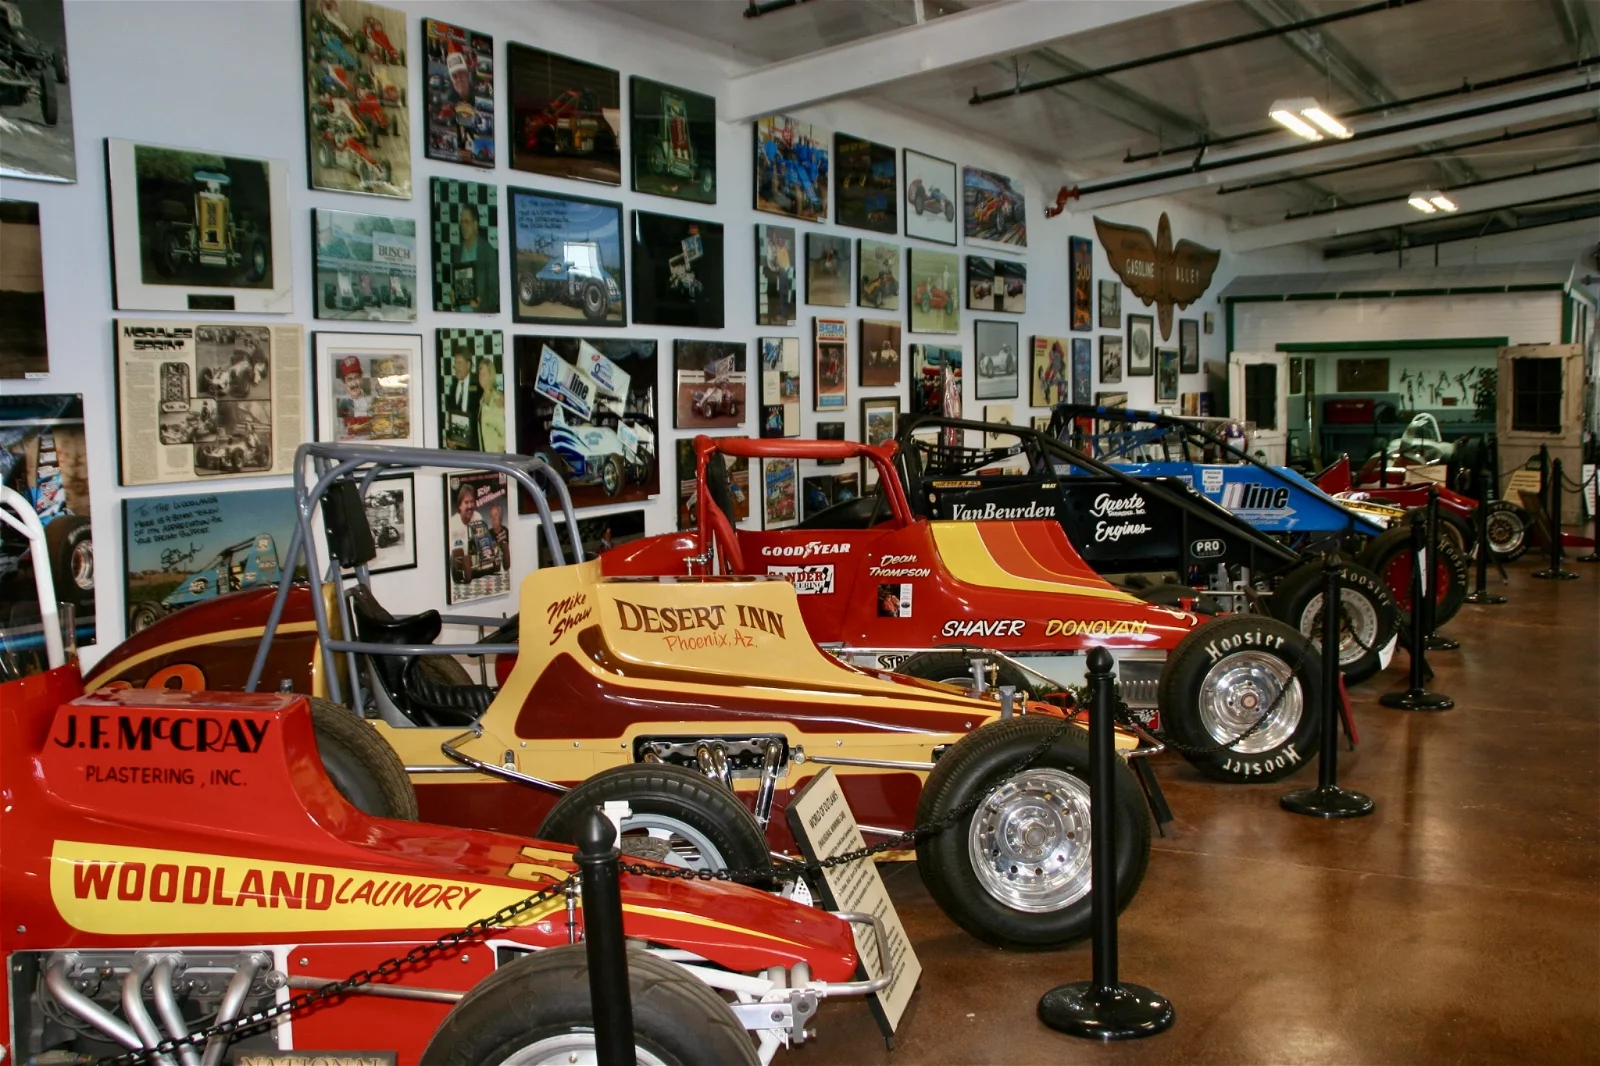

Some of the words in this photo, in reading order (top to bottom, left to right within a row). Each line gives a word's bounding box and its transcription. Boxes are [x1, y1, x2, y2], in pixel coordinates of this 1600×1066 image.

[378, 244, 410, 259] BUSCH
[1075, 261, 1091, 281] 500
[1125, 258, 1155, 279] GASOLINE
[1175, 266, 1199, 284] ALLEY
[123, 326, 193, 339] MORALES
[133, 339, 185, 351] SPRINT
[476, 485, 491, 497] Rip
[952, 500, 1056, 520] VanBeurden
[1089, 492, 1146, 517] Gaerte
[1094, 520, 1152, 542] Engines
[1196, 540, 1220, 552] PRO
[880, 553, 918, 567] Dean
[869, 566, 931, 578] THOMPSON
[547, 591, 587, 625] Mike
[612, 597, 727, 633] DESERT
[735, 604, 787, 640] INN
[549, 606, 593, 646] Shaw
[941, 619, 1026, 637] SHAVER
[1045, 619, 1149, 637] DONOVAN
[663, 630, 732, 652] Phoenix,
[733, 629, 758, 648] Az.
[1204, 627, 1285, 663] Hoosier
[53, 715, 111, 749] J.F.
[117, 716, 271, 753] McCRAY
[1222, 741, 1302, 779] Hoosier
[209, 769, 248, 787] INC.
[808, 809, 822, 830] WORLD
[822, 789, 839, 813] OUTLAWS
[74, 859, 335, 911] WOODLAND
[335, 877, 482, 911] LAUNDRY
